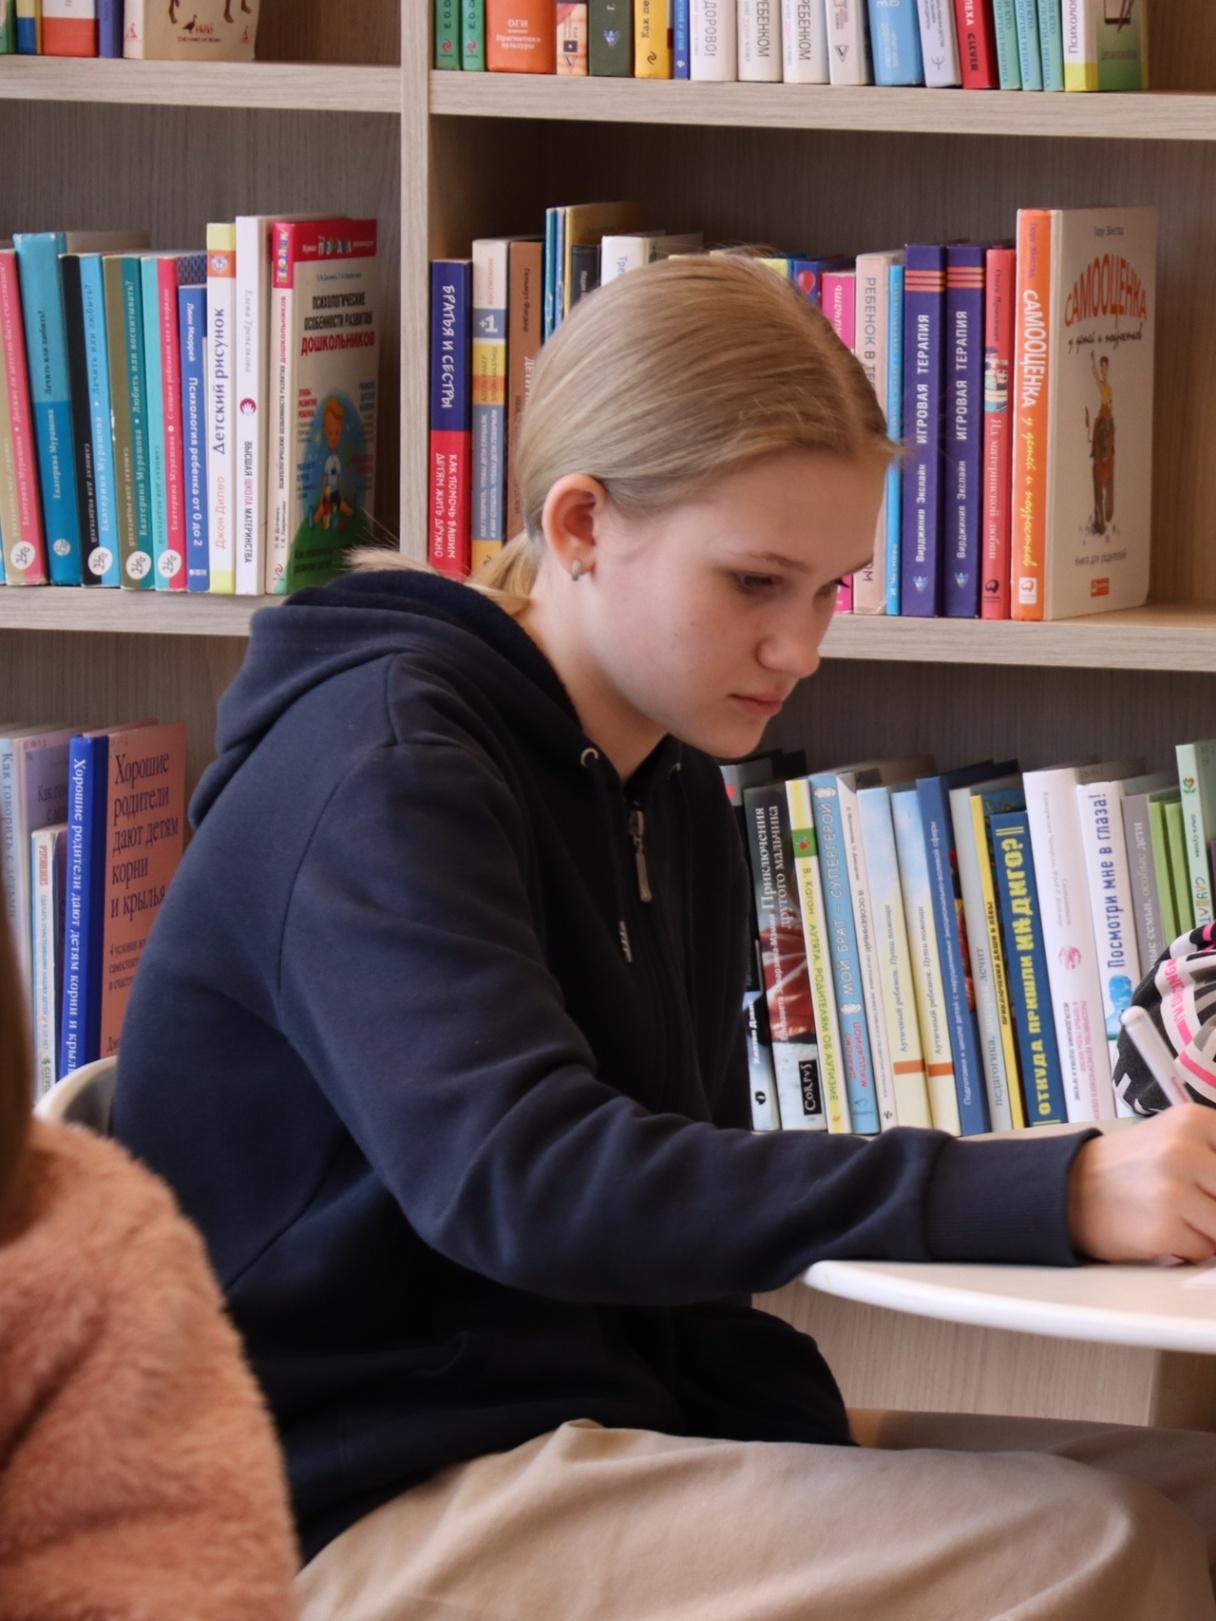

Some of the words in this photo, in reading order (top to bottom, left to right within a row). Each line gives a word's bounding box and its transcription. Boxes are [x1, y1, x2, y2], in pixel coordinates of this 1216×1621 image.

[312, 291, 366, 310] ПСИХОЛОГИЧЕСКИЕ
[441, 284, 456, 338] БРАТЬЯ
[1064, 253, 1148, 328] САМООЦЕНКА
[279, 296, 287, 364] ДОШКОЛЬНИКОВ
[304, 313, 344, 331] ОСОБЕННОСТИ
[344, 311, 373, 328] РАЗВИТИЯ
[479, 314, 499, 333] +1
[955, 310, 968, 372] ТЕРАПИЯ
[130, 352, 138, 372] или
[213, 307, 229, 380] рисунок
[301, 331, 375, 357] ДОШКОЛЬНИКОВ
[441, 340, 454, 351] И
[916, 315, 930, 375] ТЕРАПИЯ
[1020, 289, 1048, 409] САМООЦЕНКА
[131, 373, 140, 413] Любить
[441, 354, 455, 409] СЕСТРЫ
[188, 376, 199, 446] Психология
[212, 383, 226, 456] Детский
[916, 383, 929, 445] ИГРОВАЯ
[955, 379, 968, 441] ИГРОВАЯ
[1022, 416, 1034, 427] у
[83, 443, 94, 479] САМОКАТ
[96, 416, 108, 473] Мурашова
[134, 429, 147, 480] Мурашова
[243, 440, 254, 477] ВЫСШАЯ
[448, 454, 457, 474] КАК
[1021, 431, 1036, 471] детей
[86, 480, 95, 497] ДЛЯ
[189, 446, 200, 496] ребенка
[435, 453, 445, 487] ДЕТЯМ
[915, 464, 927, 504] Экслайн
[956, 460, 967, 500] Экслайн
[987, 441, 1000, 517] материнской
[1025, 475, 1034, 486] и
[99, 474, 109, 532] Екатерина
[137, 483, 148, 536] Екатерина
[192, 495, 201, 510] от
[243, 478, 254, 506] ШКОЛА
[434, 488, 445, 517] ЖИТЬ
[447, 476, 457, 520] ПОМОЧЬ
[87, 499, 98, 543] РОДИТЕЛЕЙ
[193, 521, 203, 537] до
[215, 516, 226, 550] Джон
[243, 507, 254, 564] МАТЕРИНСТВА
[434, 518, 444, 558] ДРУЖНО
[447, 520, 457, 560] ВАШИМ
[915, 508, 925, 563] Вирджиния
[956, 504, 967, 559] Вирджиния
[988, 519, 1000, 560] любви
[1019, 490, 1037, 568] подростков
[194, 538, 203, 547] 2
[72, 758, 87, 822] Хорошие
[114, 752, 171, 790] Хорошие
[112, 786, 170, 827] родители
[1088, 792, 1112, 841] глаза!
[112, 827, 144, 856] дают
[144, 816, 179, 847] детям
[769, 804, 785, 870] мальчика
[1099, 846, 1113, 855] в
[1134, 821, 1147, 851] дети
[71, 825, 83, 890] родители
[111, 858, 149, 890] корни
[755, 807, 777, 910] Приключения
[1100, 860, 1117, 890] мне
[70, 892, 82, 927] дают
[111, 897, 119, 918] и
[122, 885, 167, 916] крылья
[775, 873, 794, 929] другого
[804, 881, 815, 915] Каган
[985, 901, 995, 926] ЛЁВЫ
[1001, 837, 1035, 951] ИНДИГО?
[1103, 895, 1126, 969] Посмотри
[1143, 902, 1157, 944] семьи,
[69, 929, 80, 970] детям
[889, 940, 898, 966] Пути
[922, 943, 933, 968] Пути
[991, 935, 1002, 960] ДАШИ
[67, 974, 80, 1016] корни
[814, 967, 830, 1032] РОДИТЕЛЯМ
[890, 969, 903, 1005] ребенок.
[925, 969, 938, 1007] ребенок.
[993, 961, 1008, 1026] ПРИКЛЮЧЕНИЯ
[1020, 955, 1042, 1034] ПРИШЛИ
[68, 1020, 77, 1029] и
[822, 1033, 833, 1050] ОБ
[895, 1005, 908, 1053] Аутичный
[930, 1007, 942, 1054] Аутичный
[824, 1052, 839, 1101] АУТИЗМЕ
[1032, 1039, 1051, 1116] ОТКУДА
